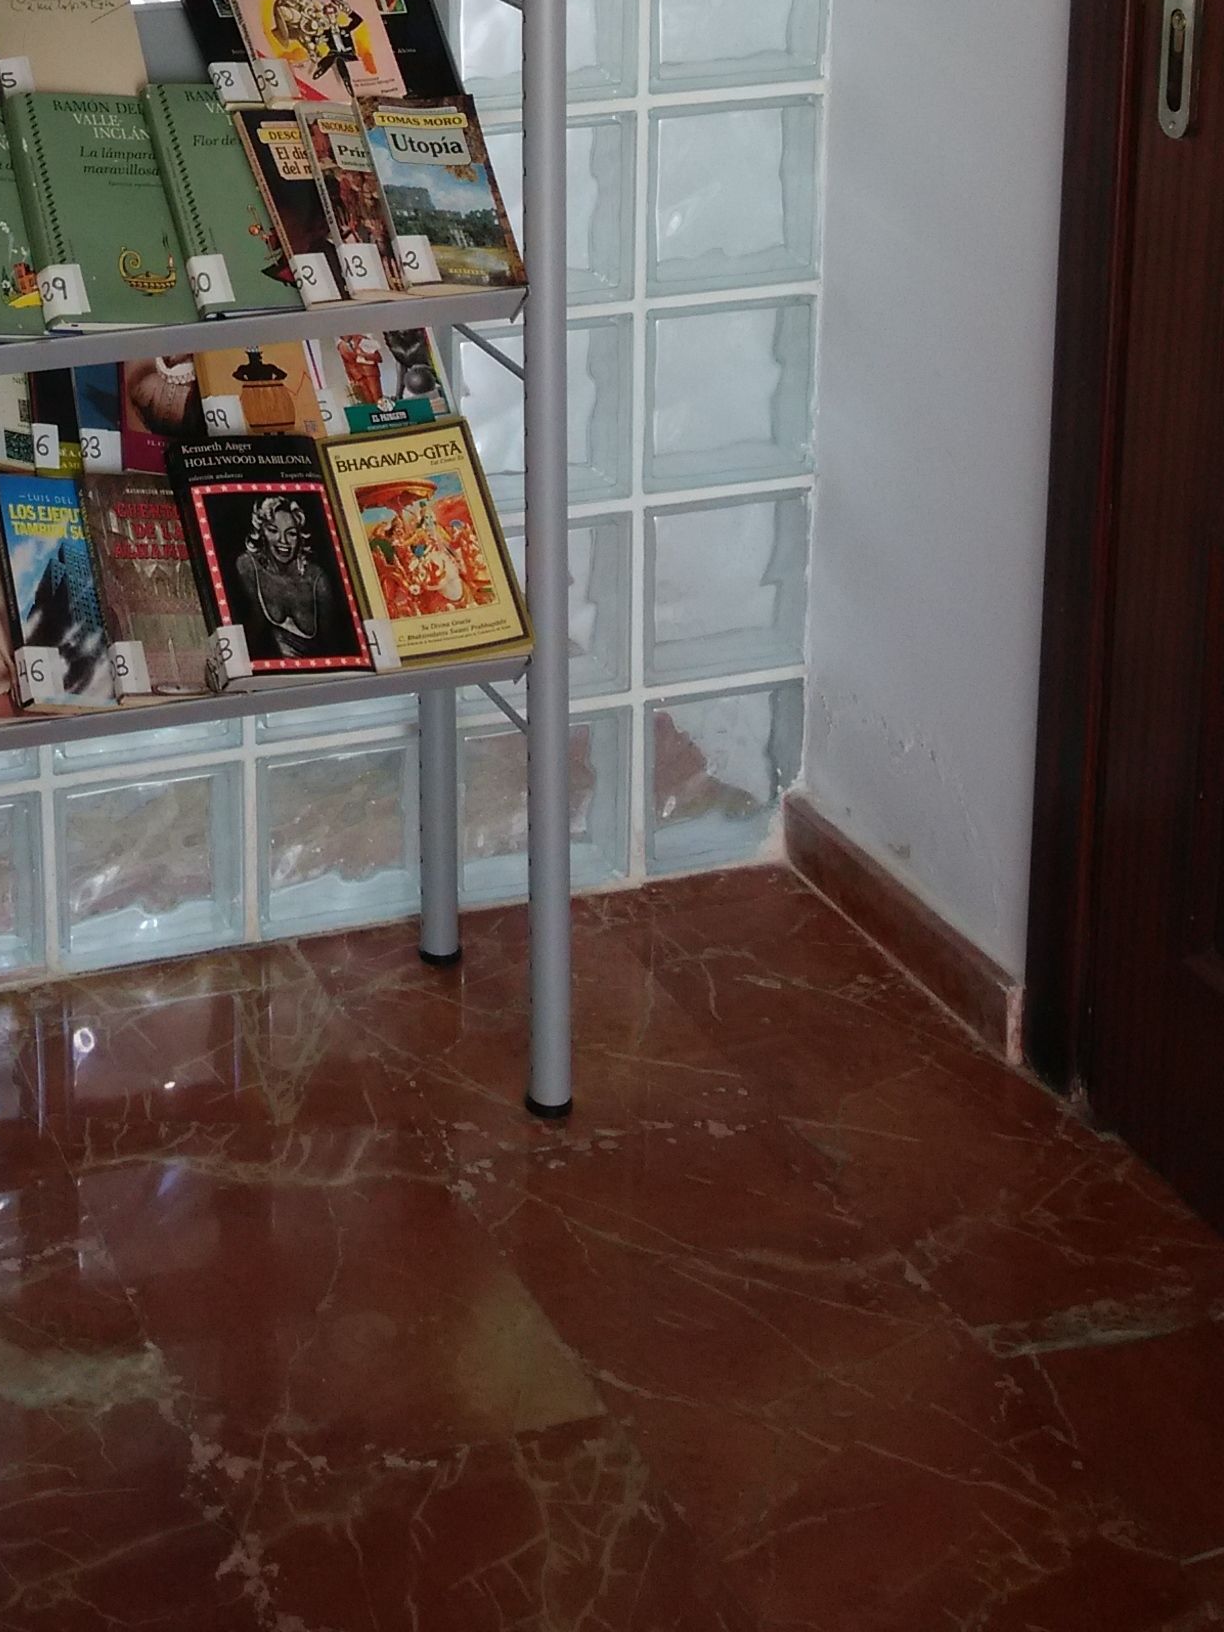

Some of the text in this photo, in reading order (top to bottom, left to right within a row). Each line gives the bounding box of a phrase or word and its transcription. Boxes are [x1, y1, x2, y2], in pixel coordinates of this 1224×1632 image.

[52, 99, 110, 114] RAMÓN
[379, 114, 464, 127] TOMAS MORO
[192, 134, 218, 147] Flor
[390, 132, 464, 158] Utopía
[79, 145, 98, 158] La
[275, 146, 291, 160] El
[282, 160, 300, 175] del
[180, 442, 252, 455] Kenneth Anger
[183, 455, 313, 469] HOLLYWOOD BABILONIA
[8, 503, 36, 520] LOS
